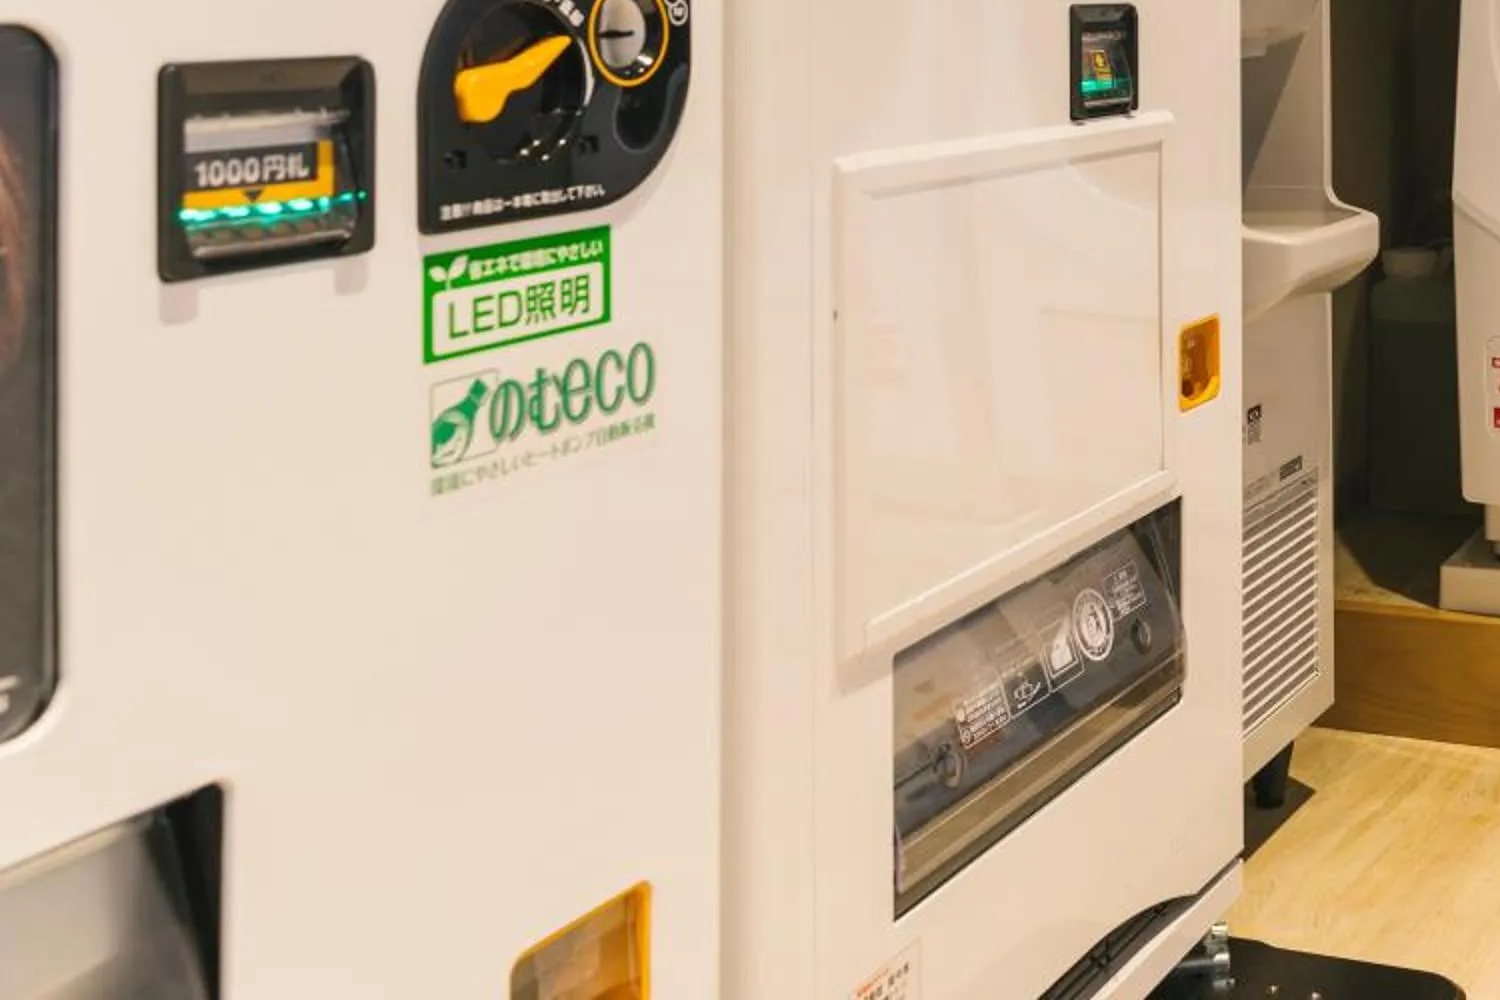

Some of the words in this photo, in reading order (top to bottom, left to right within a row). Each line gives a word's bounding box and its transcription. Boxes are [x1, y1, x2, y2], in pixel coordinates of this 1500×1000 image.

[194, 152, 310, 187] 1000円札
[449, 274, 591, 339] LED照明
[489, 341, 656, 442] のむeco
